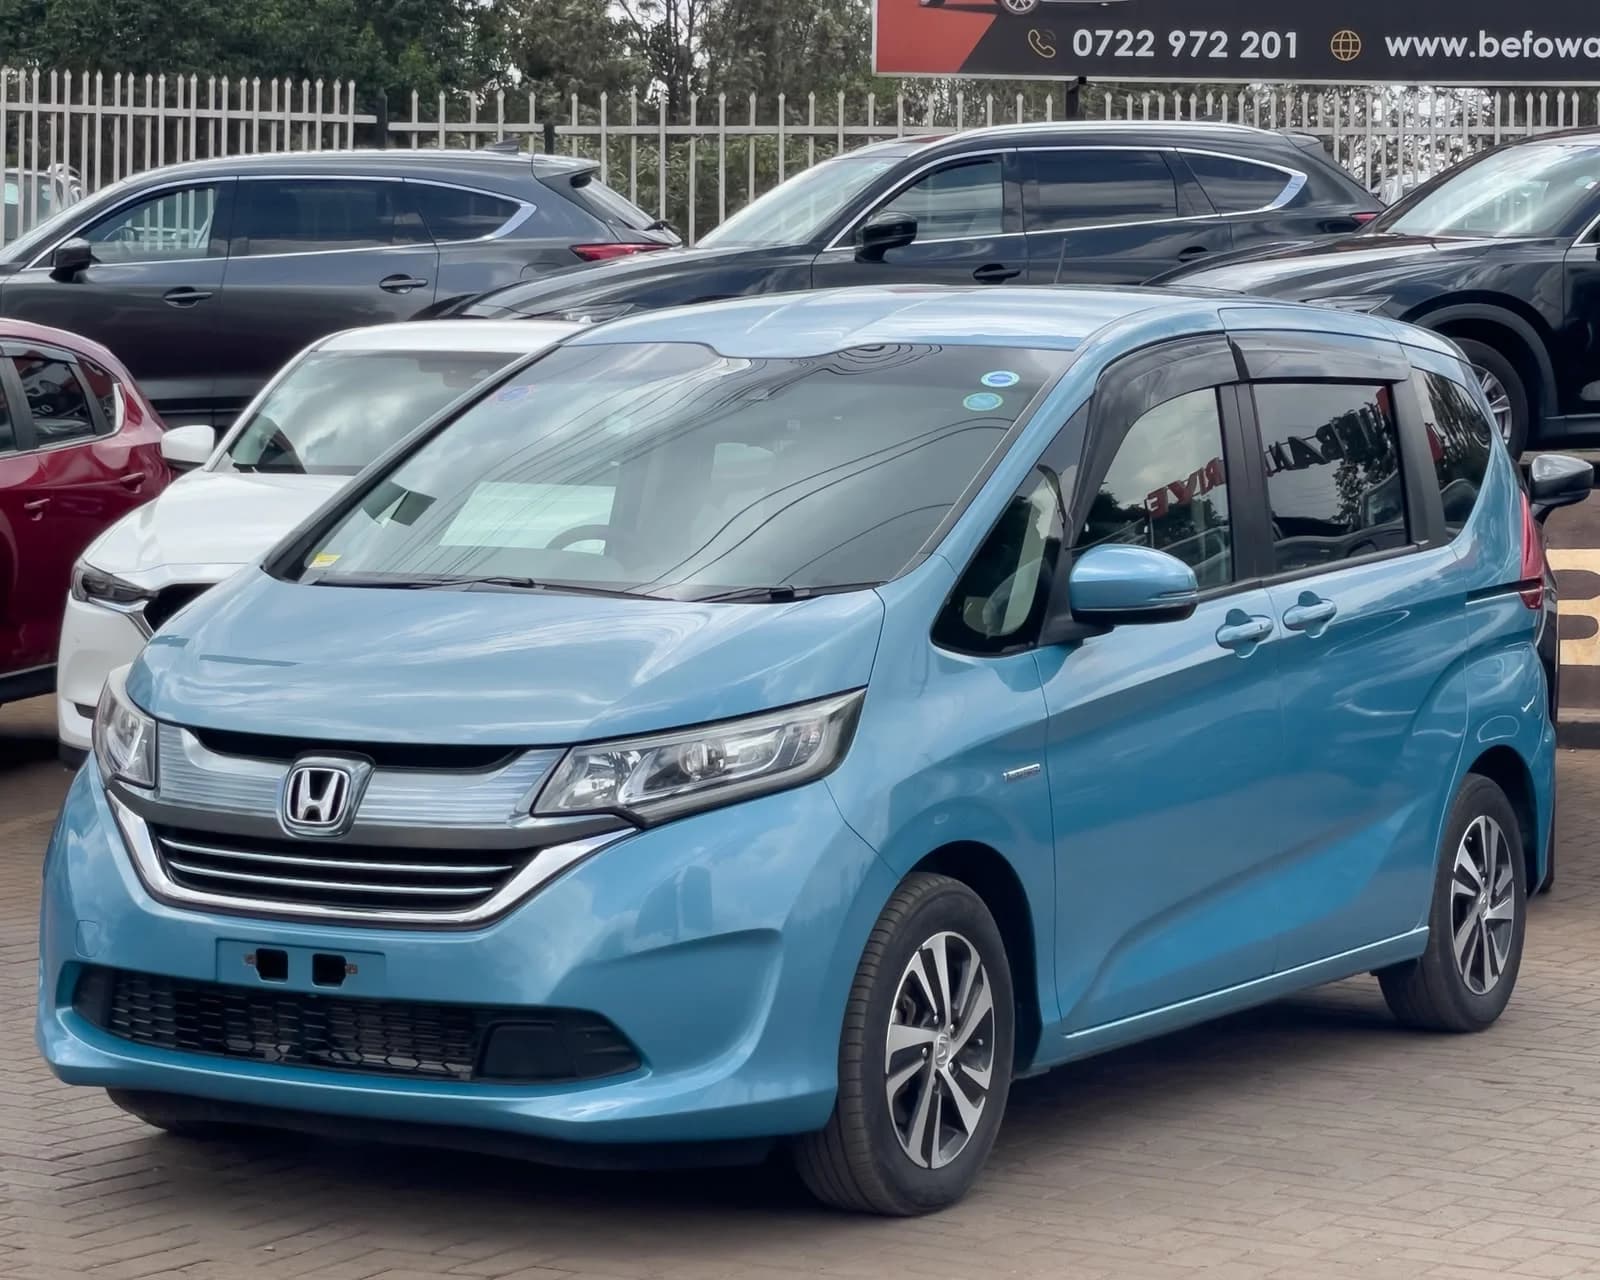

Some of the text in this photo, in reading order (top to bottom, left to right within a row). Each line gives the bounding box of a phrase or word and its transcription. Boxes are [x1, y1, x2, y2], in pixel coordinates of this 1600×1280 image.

[1073, 29, 1297, 59] 0722 972 201
